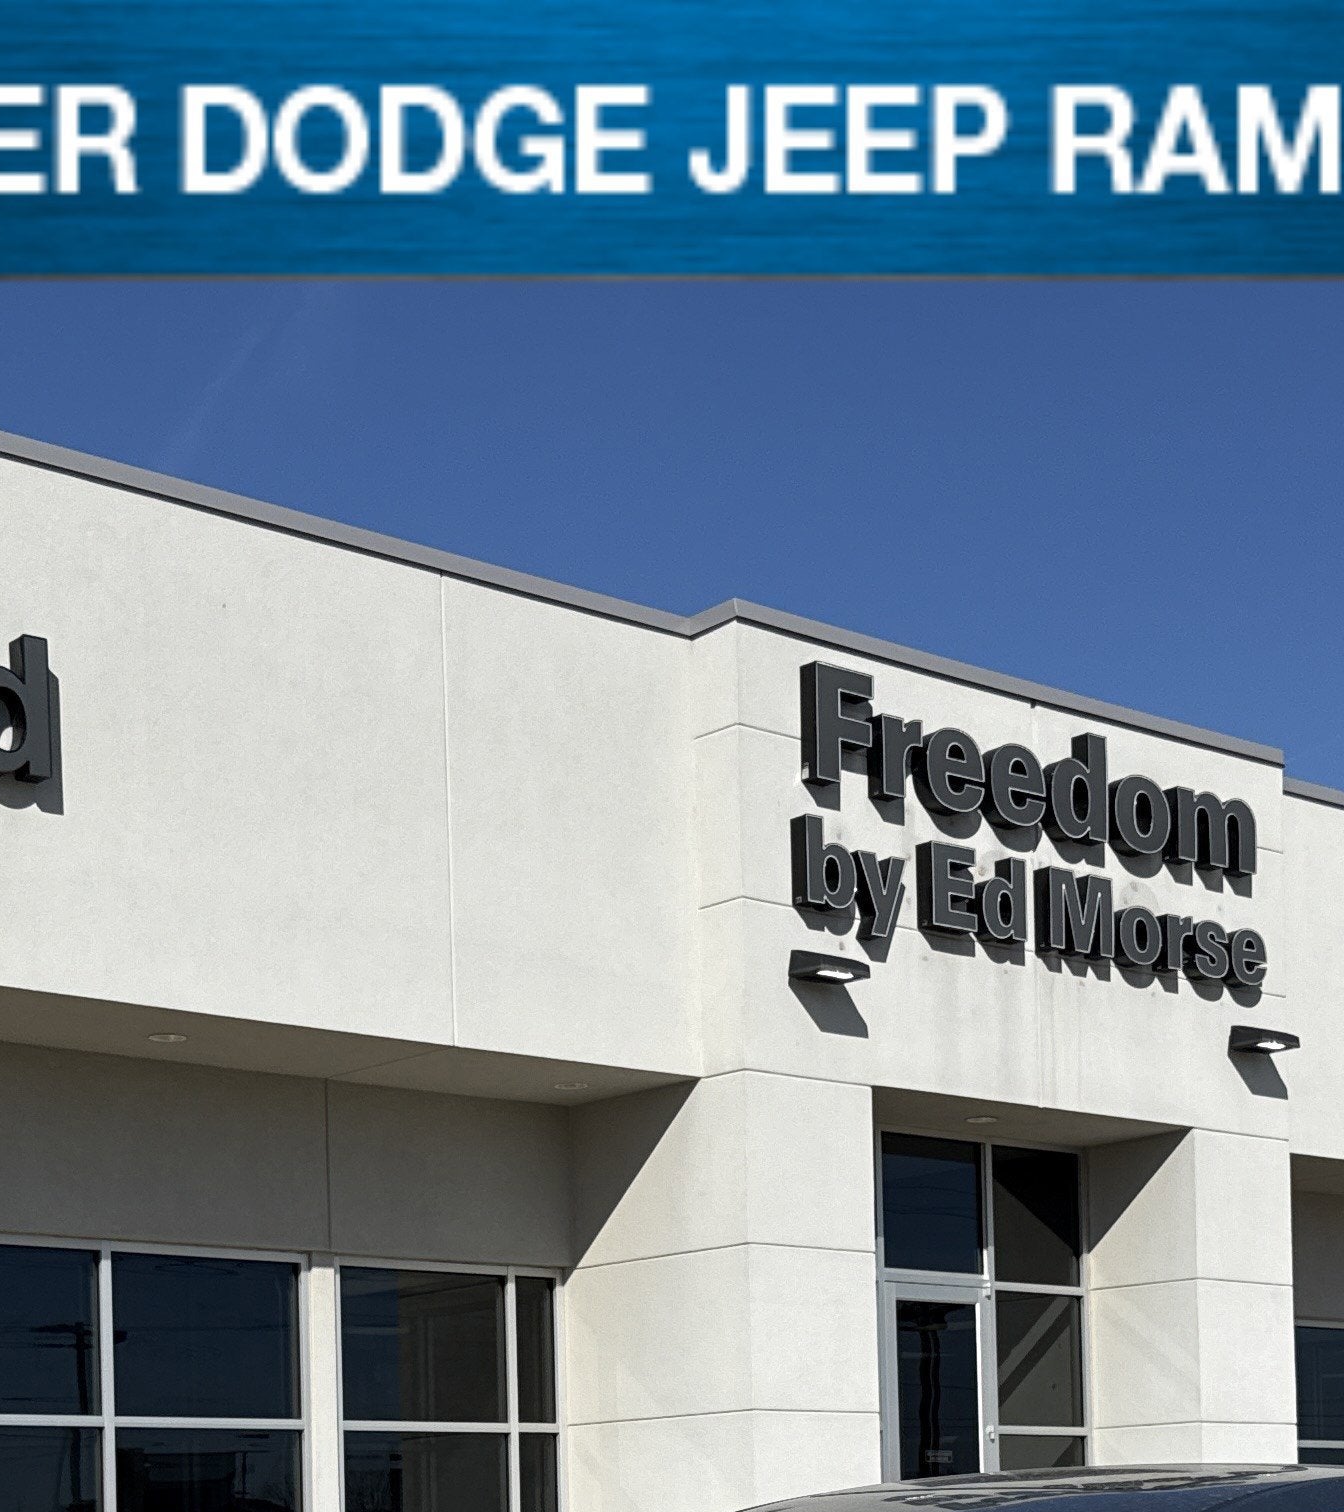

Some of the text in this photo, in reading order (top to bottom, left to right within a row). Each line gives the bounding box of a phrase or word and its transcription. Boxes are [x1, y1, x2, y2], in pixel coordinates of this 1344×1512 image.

[800, 661, 1257, 876] Freedom
[790, 814, 1268, 986] by Ed Morse
